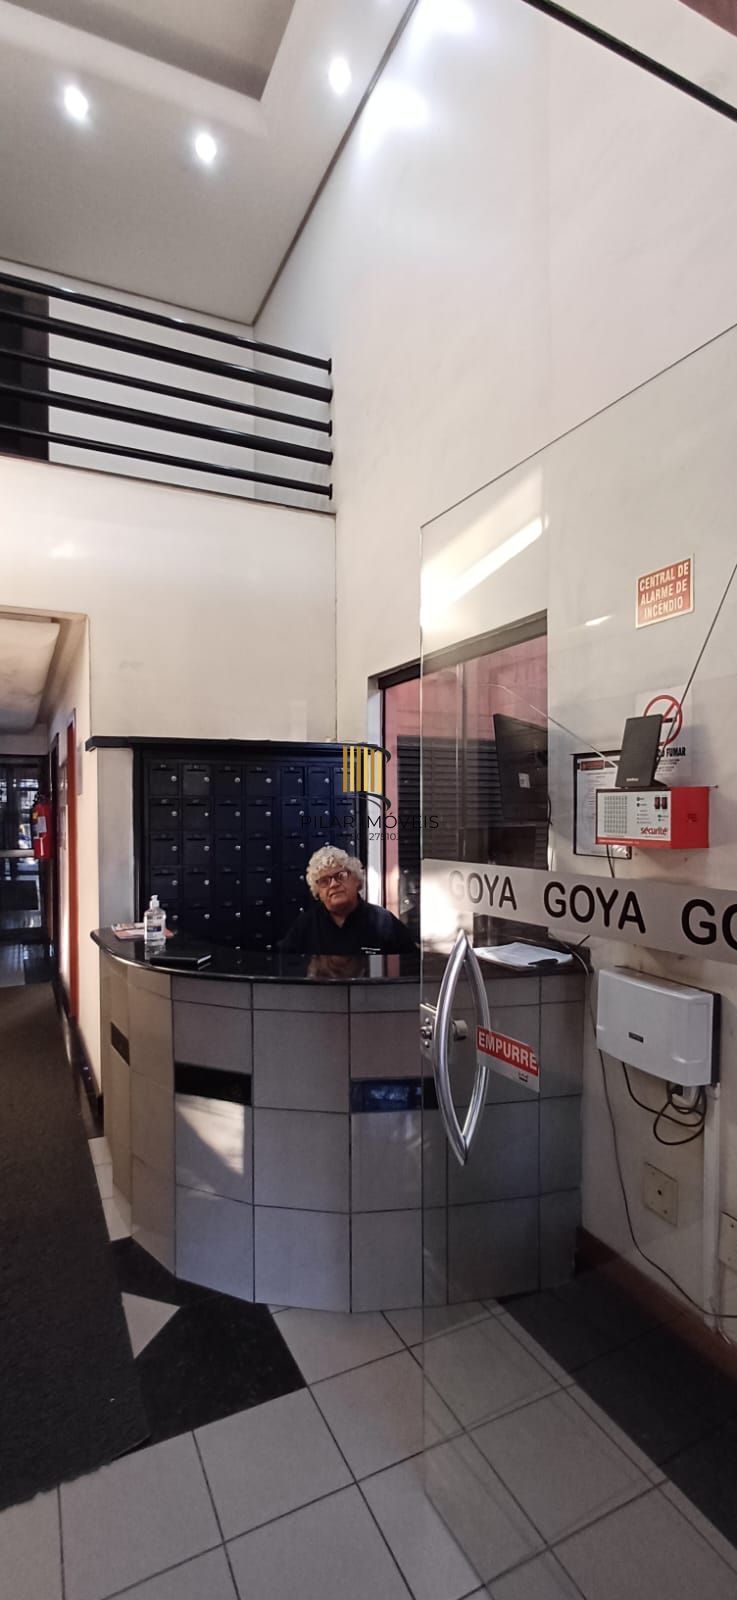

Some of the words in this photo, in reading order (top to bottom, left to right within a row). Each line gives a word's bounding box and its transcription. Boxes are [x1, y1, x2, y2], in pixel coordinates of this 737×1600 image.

[639, 567, 676, 591] CENTRAL
[677, 562, 689, 578] DE
[640, 582, 674, 606] ALARME
[676, 578, 688, 594] DE
[666, 746, 686, 757] FUMAR
[448, 869, 518, 911] GOYA
[543, 881, 647, 934] GOYA
[478, 1031, 538, 1071] EMPURRE
